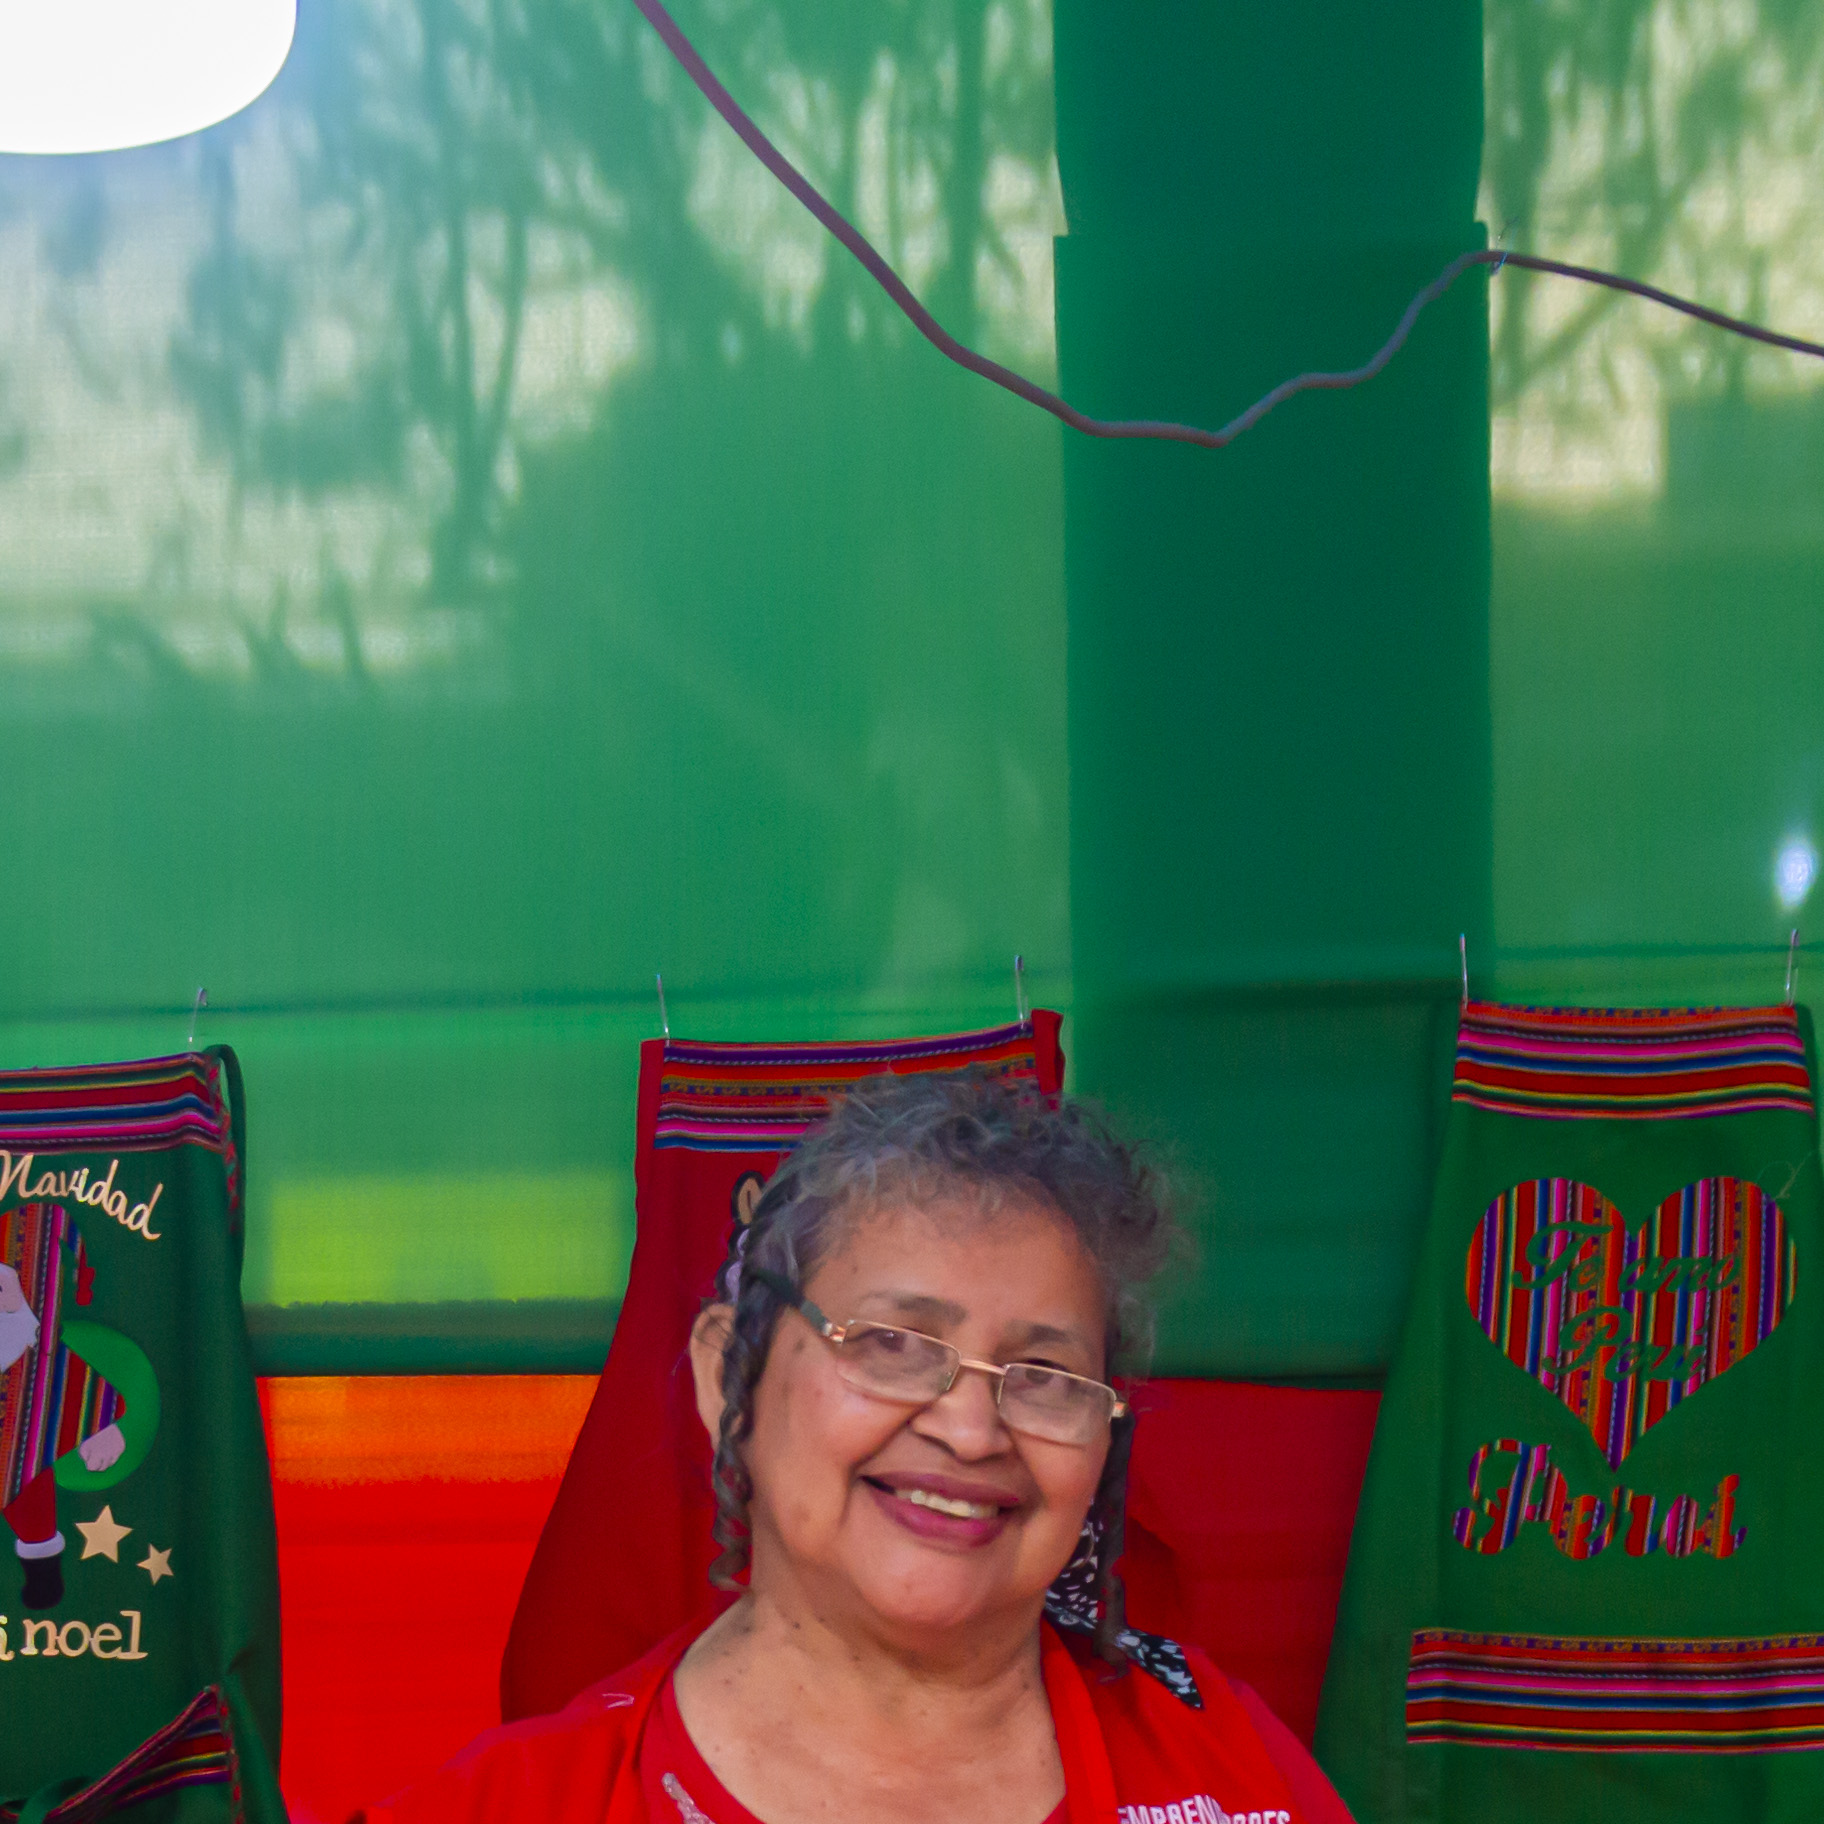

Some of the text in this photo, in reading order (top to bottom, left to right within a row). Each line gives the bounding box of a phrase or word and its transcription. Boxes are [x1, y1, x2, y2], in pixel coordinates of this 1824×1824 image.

[1511, 1220, 1741, 1293] Te amo
[21, 1610, 149, 1660] noel
